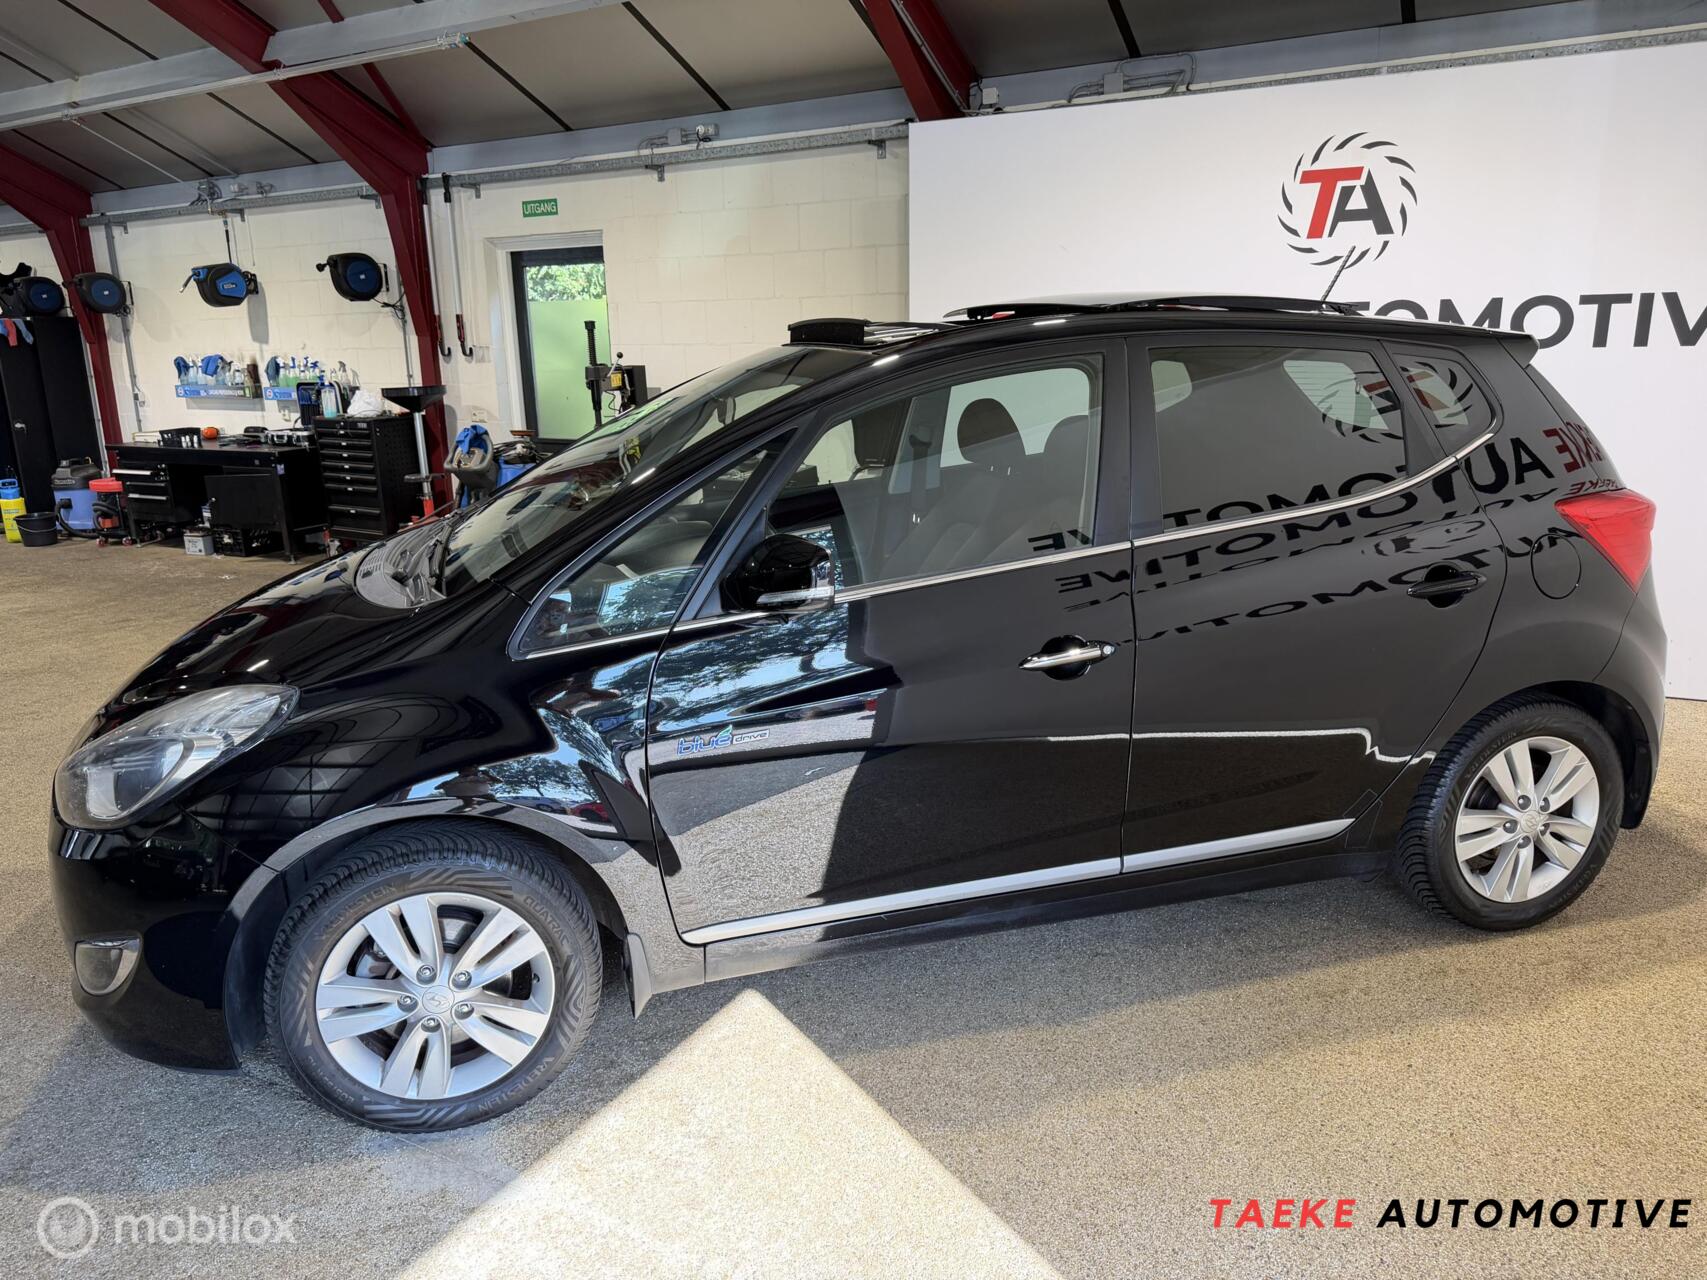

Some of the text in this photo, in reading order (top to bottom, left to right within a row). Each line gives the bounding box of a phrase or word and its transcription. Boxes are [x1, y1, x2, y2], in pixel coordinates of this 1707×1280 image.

[523, 202, 557, 215] UITGANG
[1299, 166, 1395, 239] TA
[1344, 292, 1707, 350] MOTIV
[677, 730, 768, 756] blue drive
